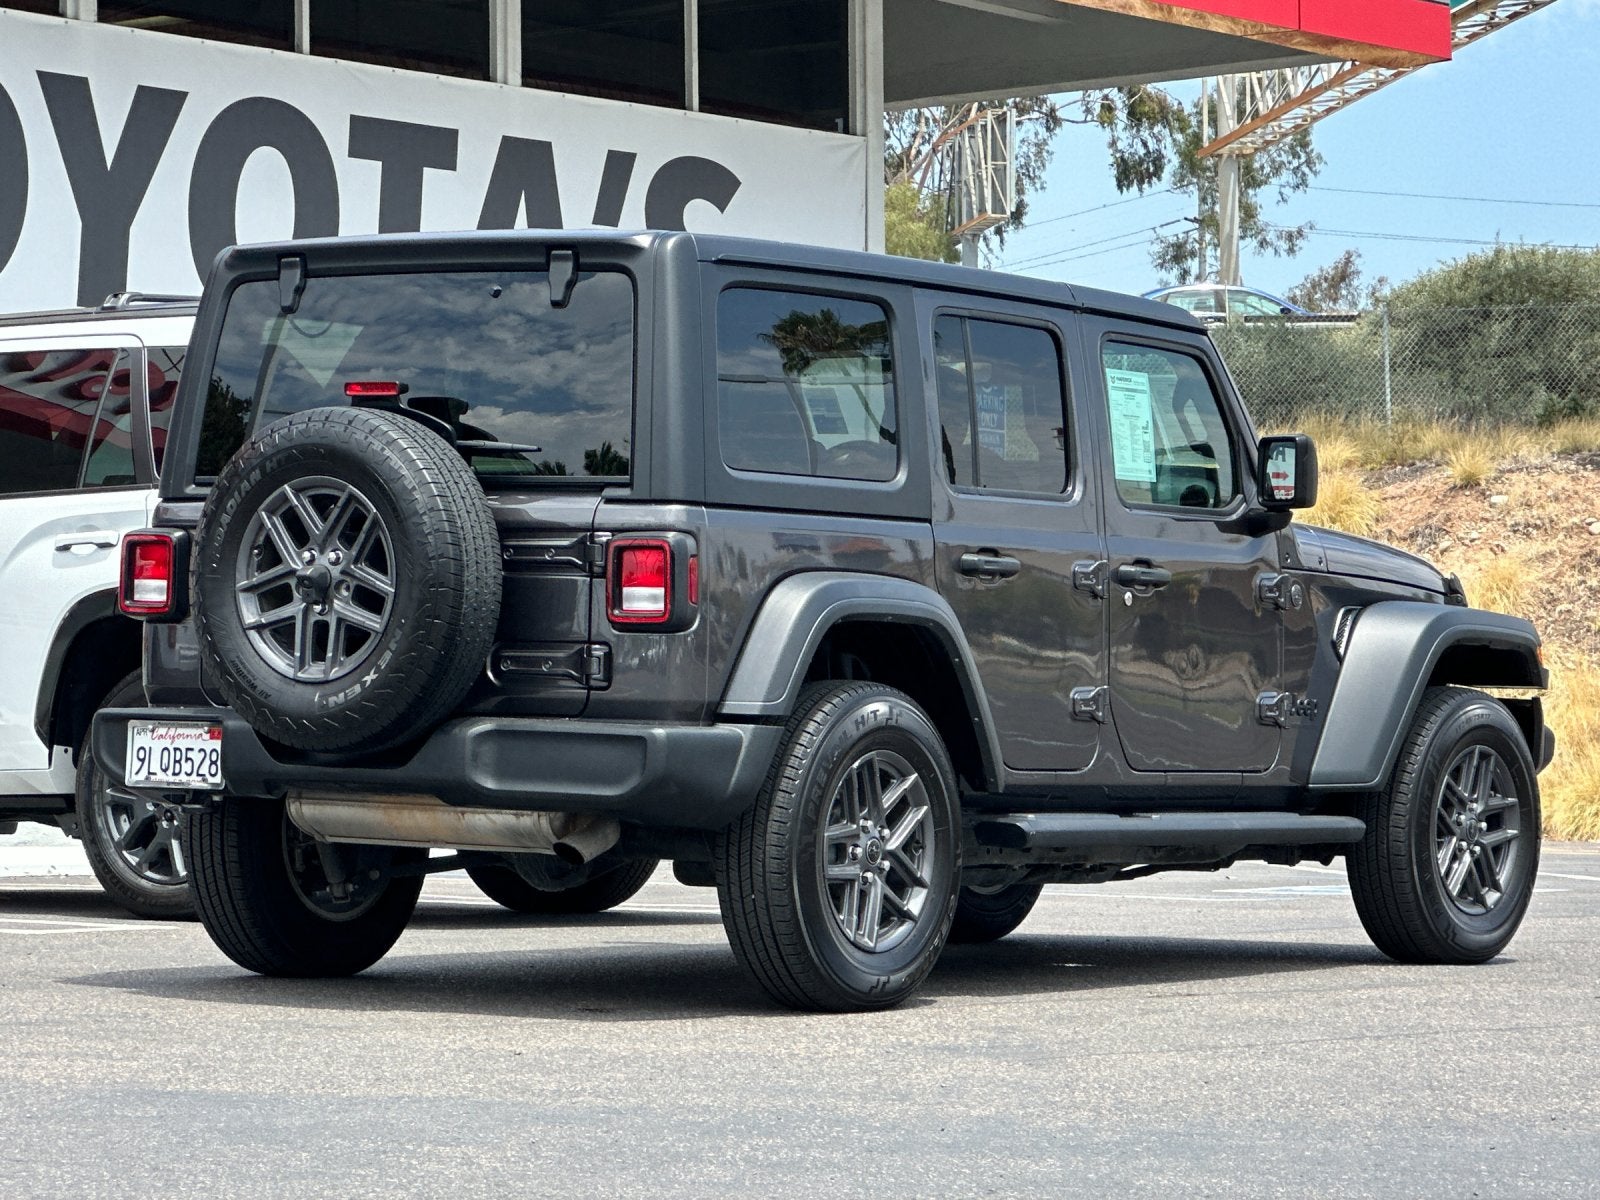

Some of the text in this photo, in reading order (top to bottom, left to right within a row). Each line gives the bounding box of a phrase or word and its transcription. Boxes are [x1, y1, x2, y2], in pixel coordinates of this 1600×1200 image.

[0, 70, 742, 309] YOTA'
[328, 628, 403, 708] NEXEN
[134, 746, 220, 777] 9LQB528
[151, 726, 205, 745] California
